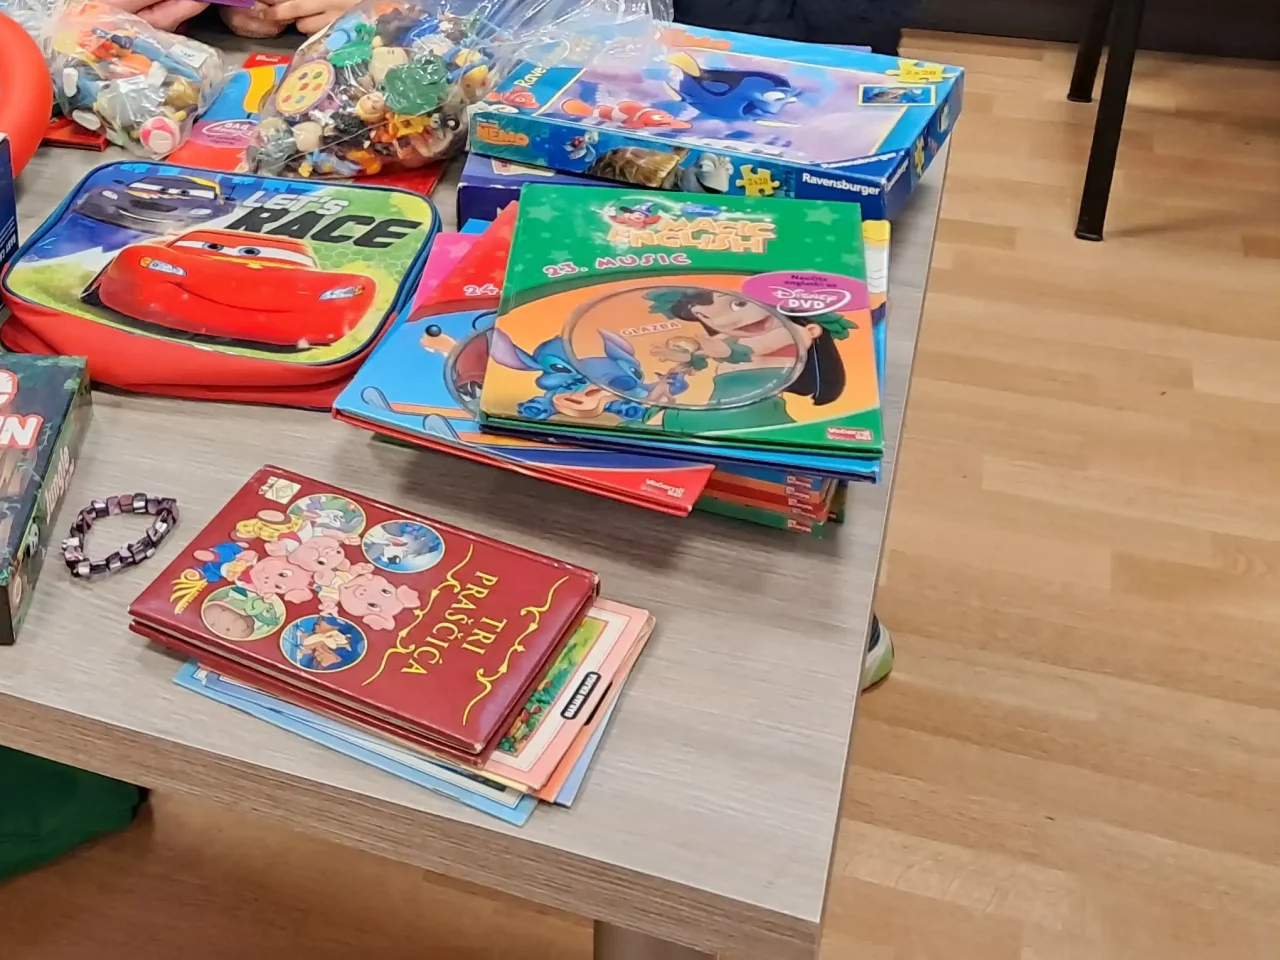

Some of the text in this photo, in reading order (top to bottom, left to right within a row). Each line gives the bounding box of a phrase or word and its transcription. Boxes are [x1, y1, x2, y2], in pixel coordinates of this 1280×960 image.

[802, 172, 881, 196] Ravensburger
[242, 190, 349, 216] LET'S
[223, 205, 423, 249] RACE
[607, 227, 767, 253] ENGLISH
[659, 218, 777, 239] MAGIC
[543, 252, 692, 278] 23. MUSIC
[788, 299, 825, 309] DVD
[621, 320, 682, 337] GLAZBA
[400, 571, 500, 675] PRAŠČIĆA
[461, 616, 508, 656] TRI
